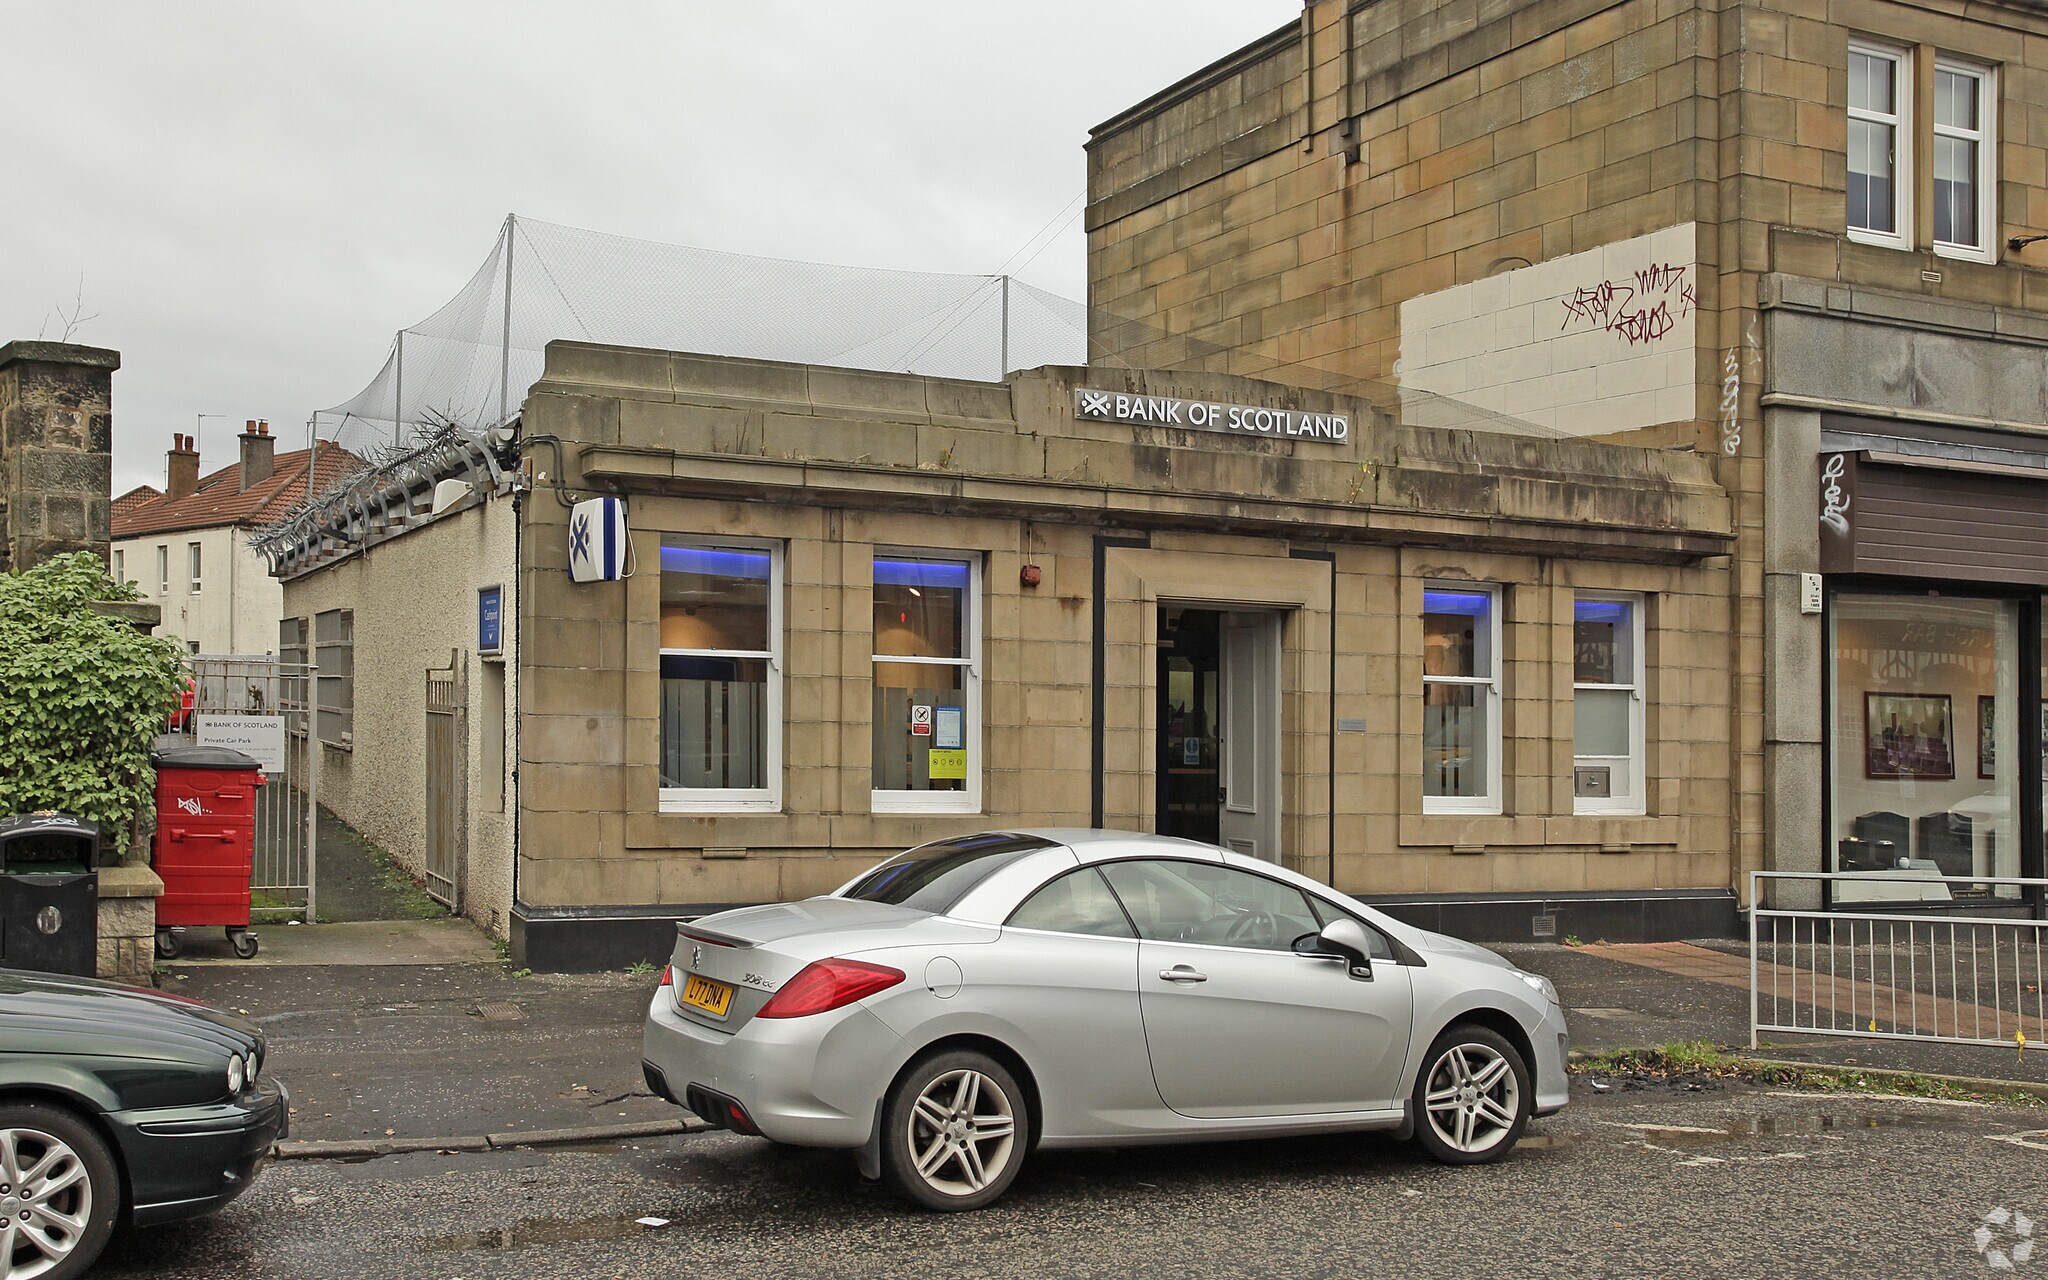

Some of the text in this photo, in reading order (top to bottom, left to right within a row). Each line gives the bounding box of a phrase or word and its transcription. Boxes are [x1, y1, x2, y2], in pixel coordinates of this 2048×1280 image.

[1115, 395, 1348, 439] BANK OF SCOTLAND
[689, 978, 725, 1008] L77 DNA
